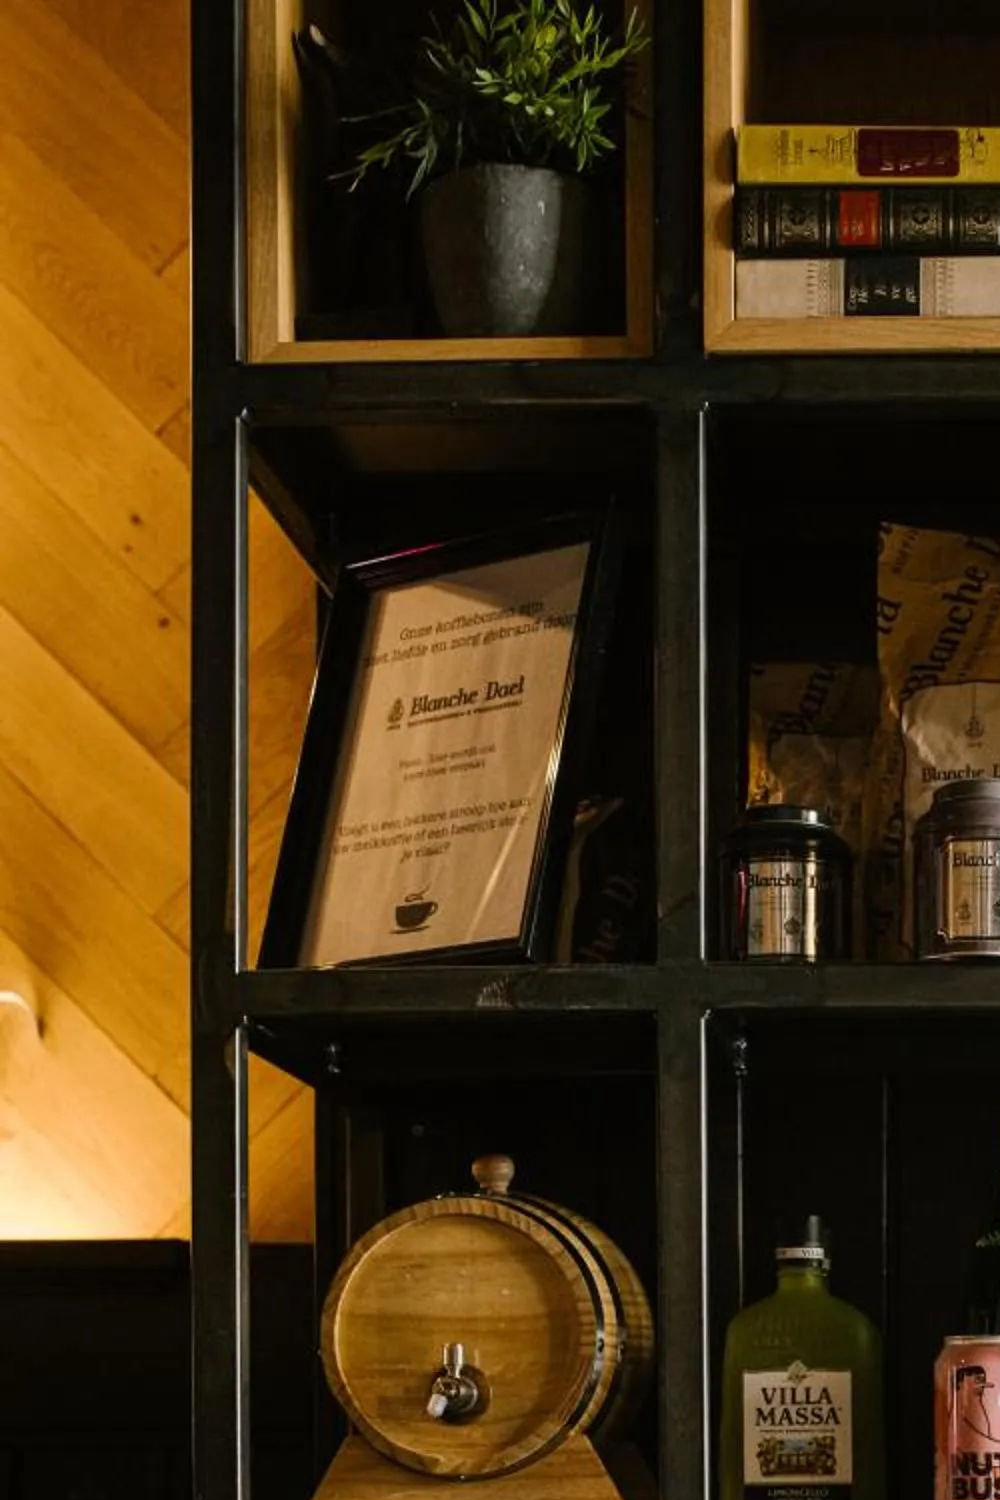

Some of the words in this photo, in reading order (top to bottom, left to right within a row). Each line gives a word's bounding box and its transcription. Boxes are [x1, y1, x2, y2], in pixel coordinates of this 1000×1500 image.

[410, 687, 479, 717] Blanche
[486, 674, 526, 702] Dael
[761, 1386, 832, 1405] VILLA
[755, 1407, 841, 1426] MASSA
